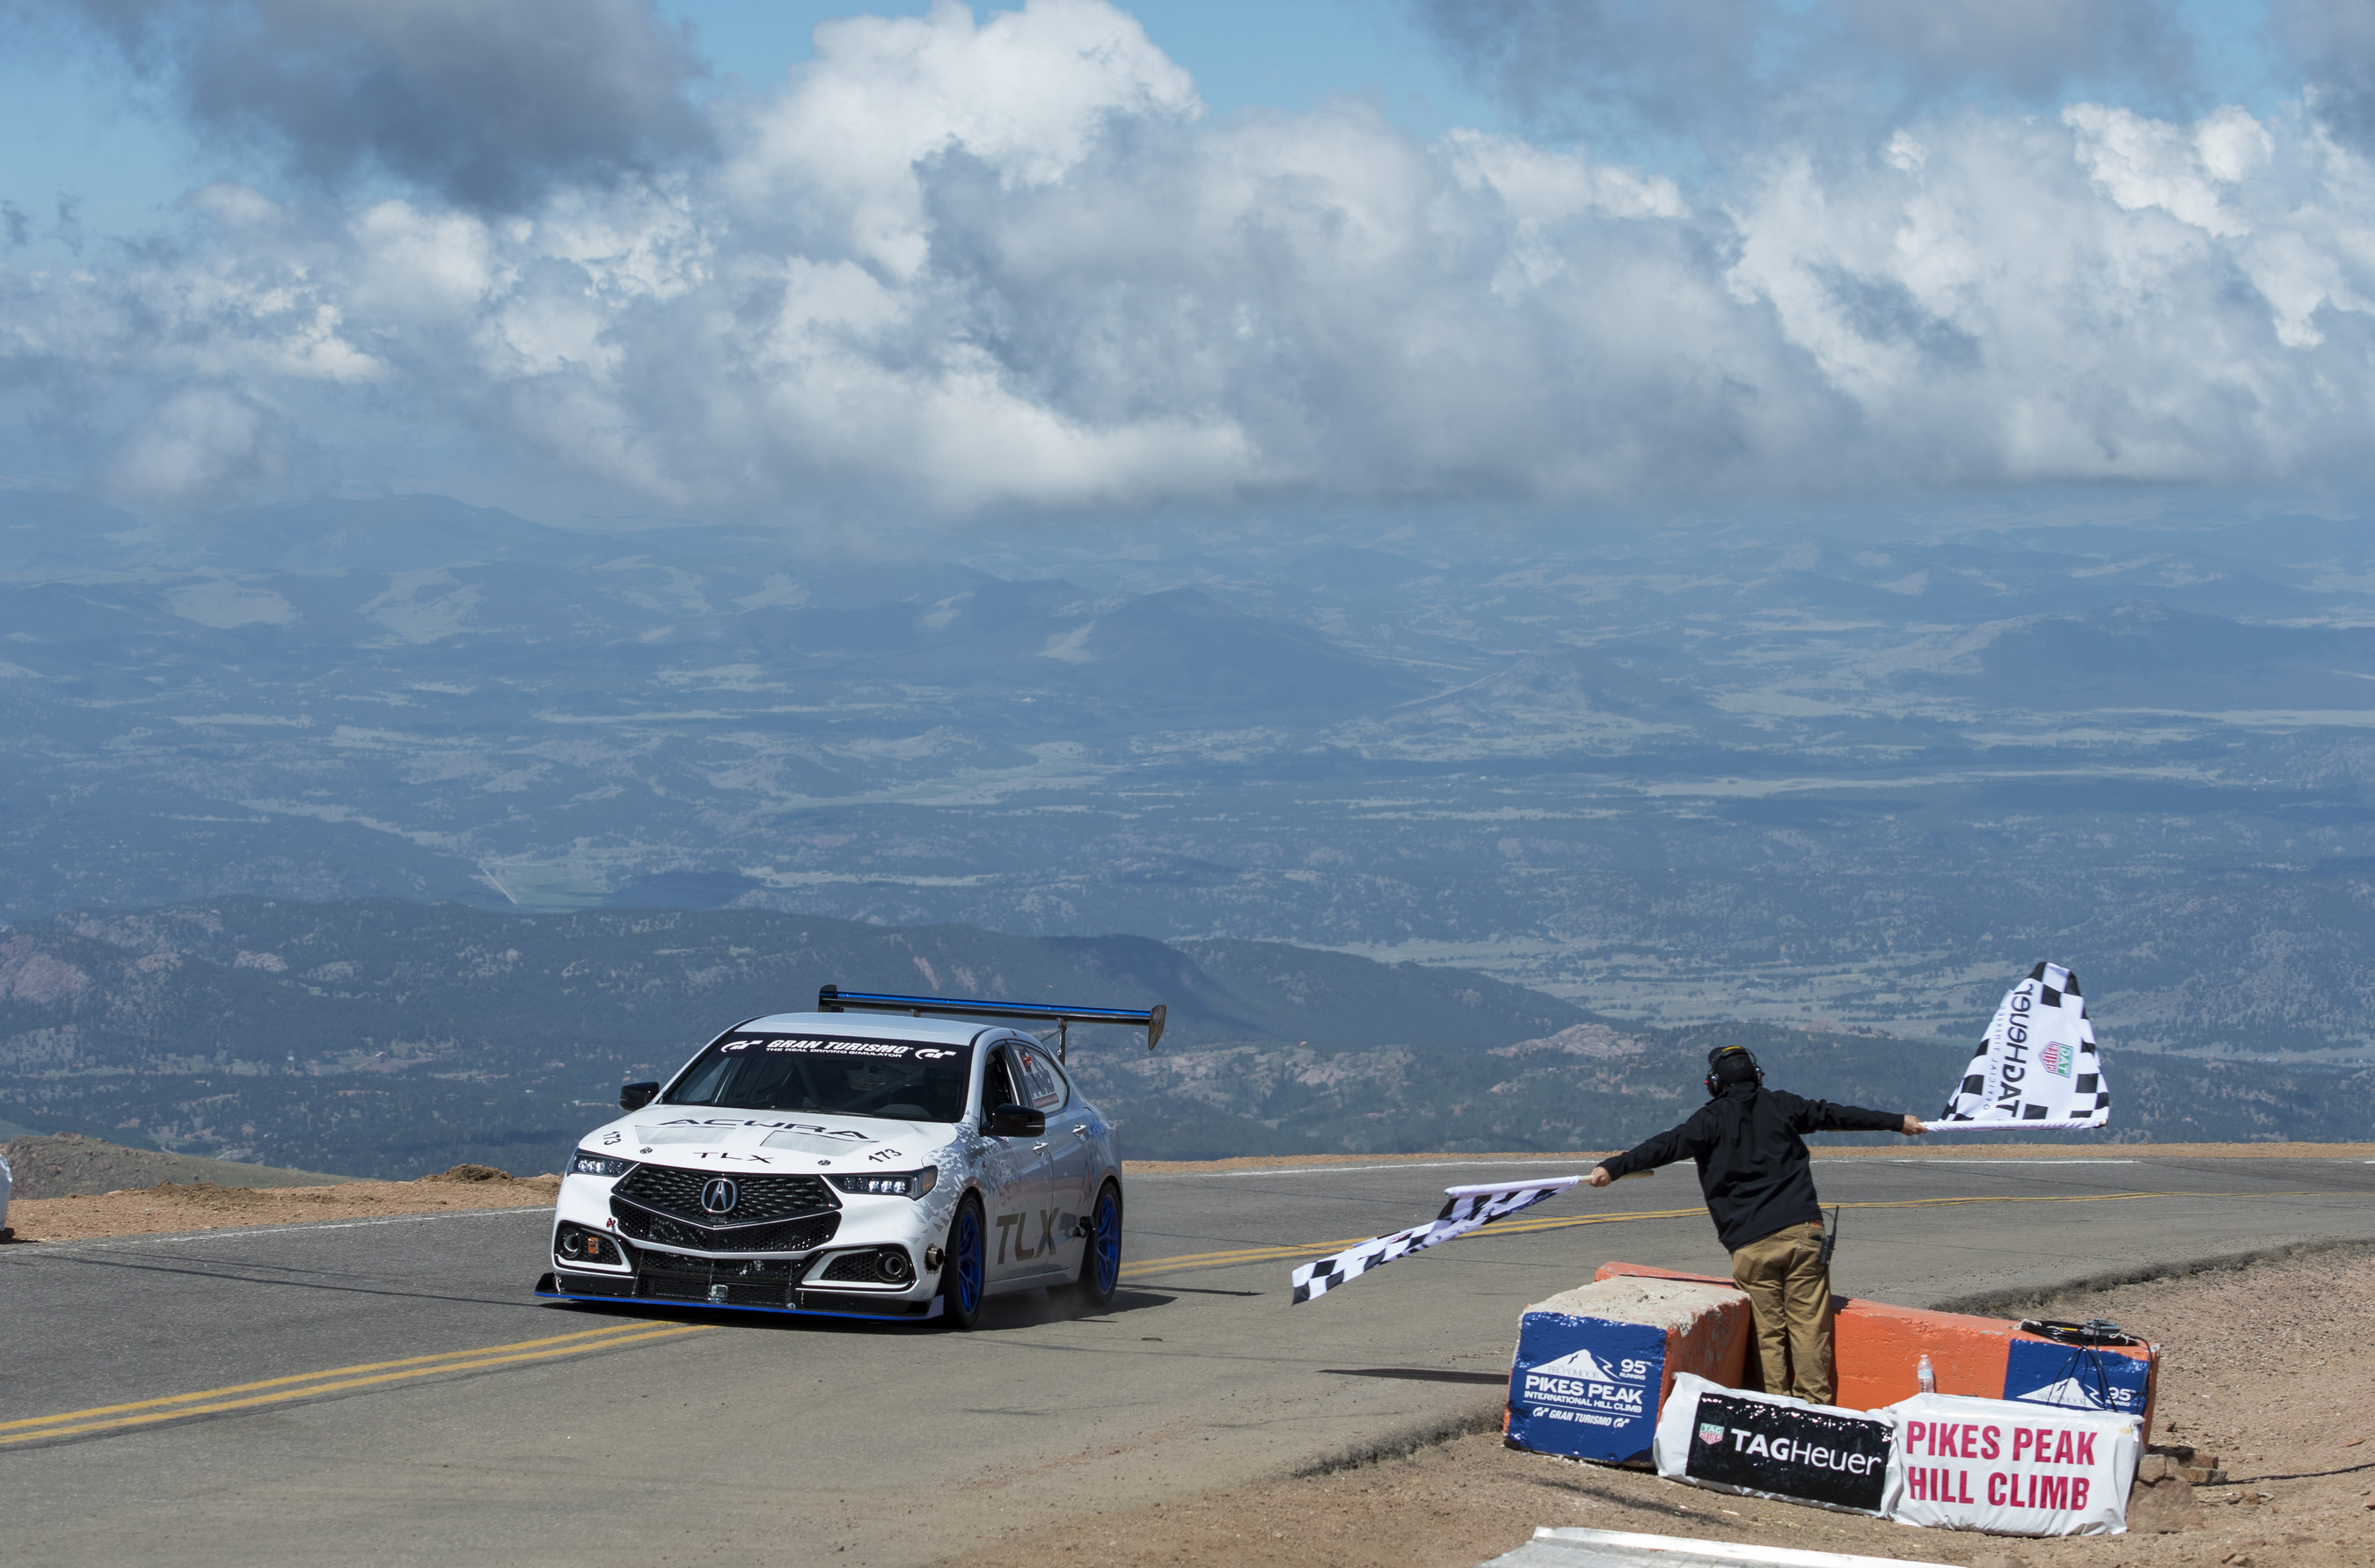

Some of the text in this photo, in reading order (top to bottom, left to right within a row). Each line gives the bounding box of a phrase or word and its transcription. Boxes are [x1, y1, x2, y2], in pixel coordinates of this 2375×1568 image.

[766, 1039, 823, 1049] GRAN
[823, 1041, 910, 1054] TURISMO
[603, 1131, 621, 1146] 173
[657, 1119, 870, 1140] ACURA
[693, 1152, 774, 1163] TLX
[868, 1148, 902, 1163] 173
[996, 1207, 1061, 1265] TLX
[1525, 1375, 1644, 1404] PIKES PEAK
[1524, 1390, 1642, 1413] INTERNATIONAL HILL CLIMB
[1549, 1409, 1575, 1421] GRAN
[1575, 1412, 1613, 1426] TURISMO
[1703, 1425, 1722, 1434] TAG
[1730, 1427, 1882, 1476] TAGHeuer
[1906, 1420, 2098, 1466] PIKES PEAK
[1908, 1466, 2090, 1512] HILL CLIMB
